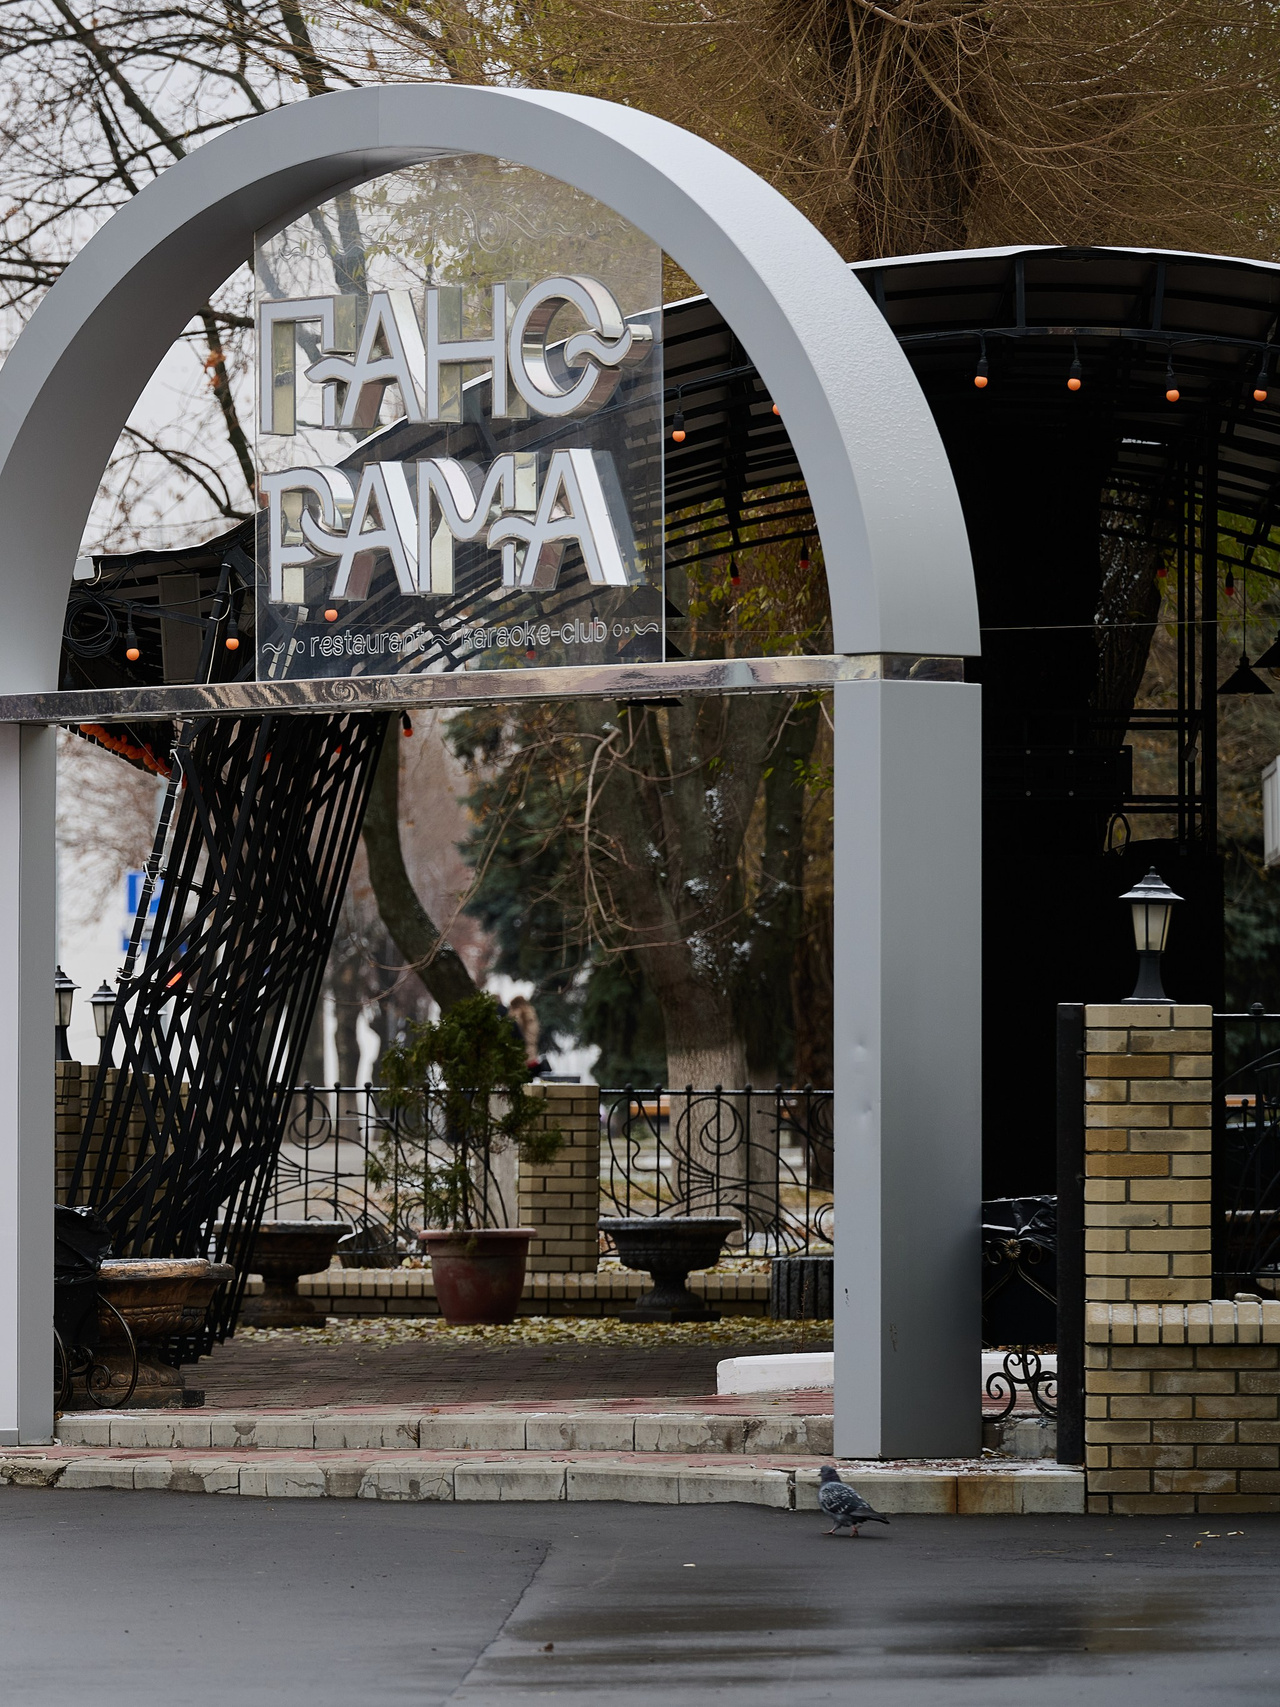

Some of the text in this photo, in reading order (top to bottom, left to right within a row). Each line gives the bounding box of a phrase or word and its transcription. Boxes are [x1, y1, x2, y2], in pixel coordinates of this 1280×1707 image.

[260, 448, 629, 604] РАМА
[310, 616, 608, 657] restaurant karaoke-club
